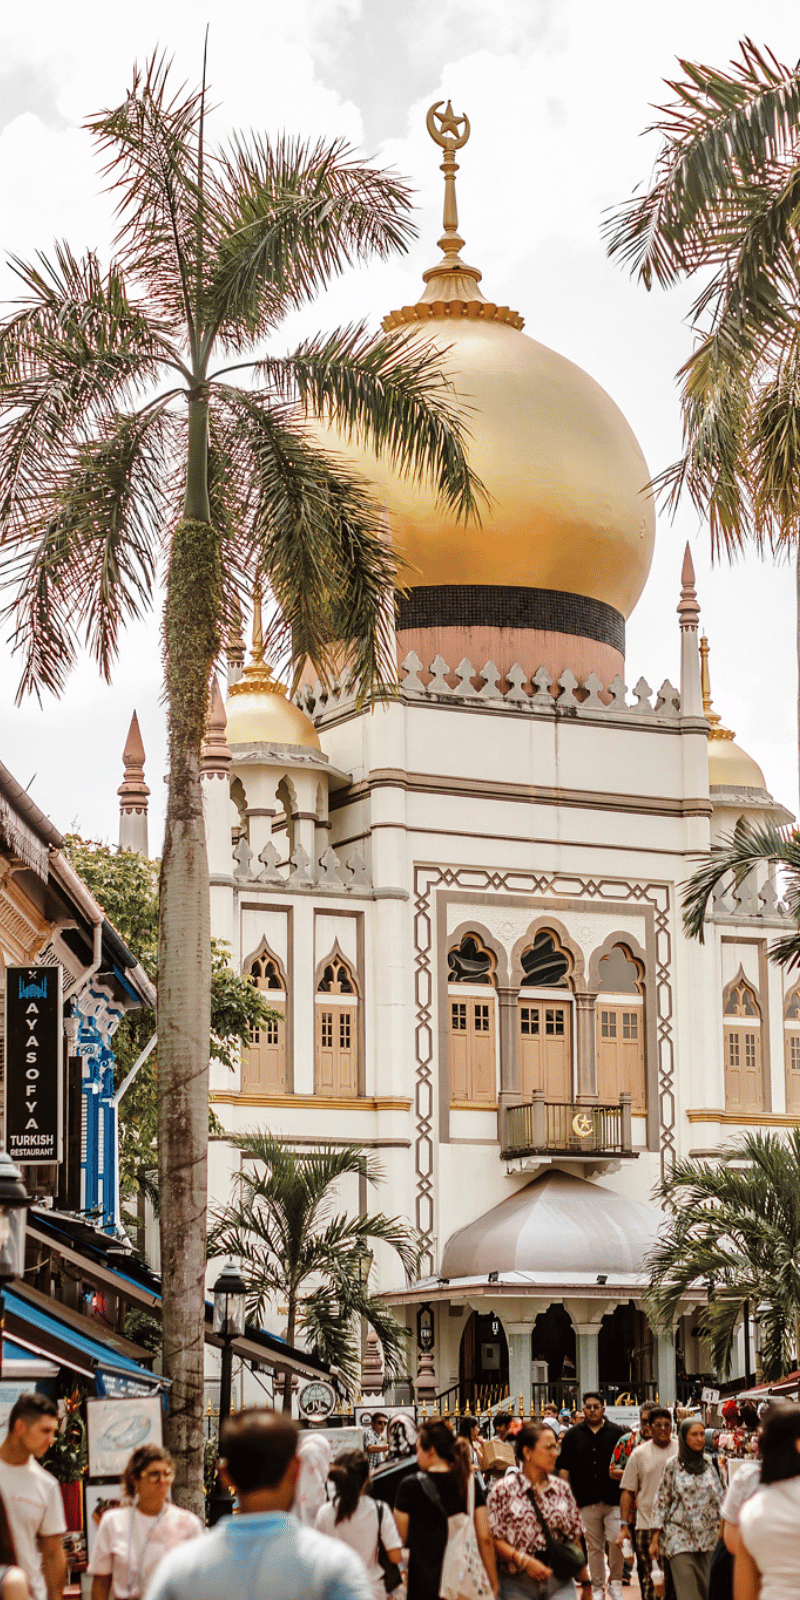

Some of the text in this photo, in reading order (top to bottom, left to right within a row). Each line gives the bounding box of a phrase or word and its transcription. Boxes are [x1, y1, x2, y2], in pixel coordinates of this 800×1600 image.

[25, 1002, 40, 1130] AYASOFYA
[10, 1134, 54, 1146] TURKISH
[10, 1147, 54, 1156] RESTAURANT
